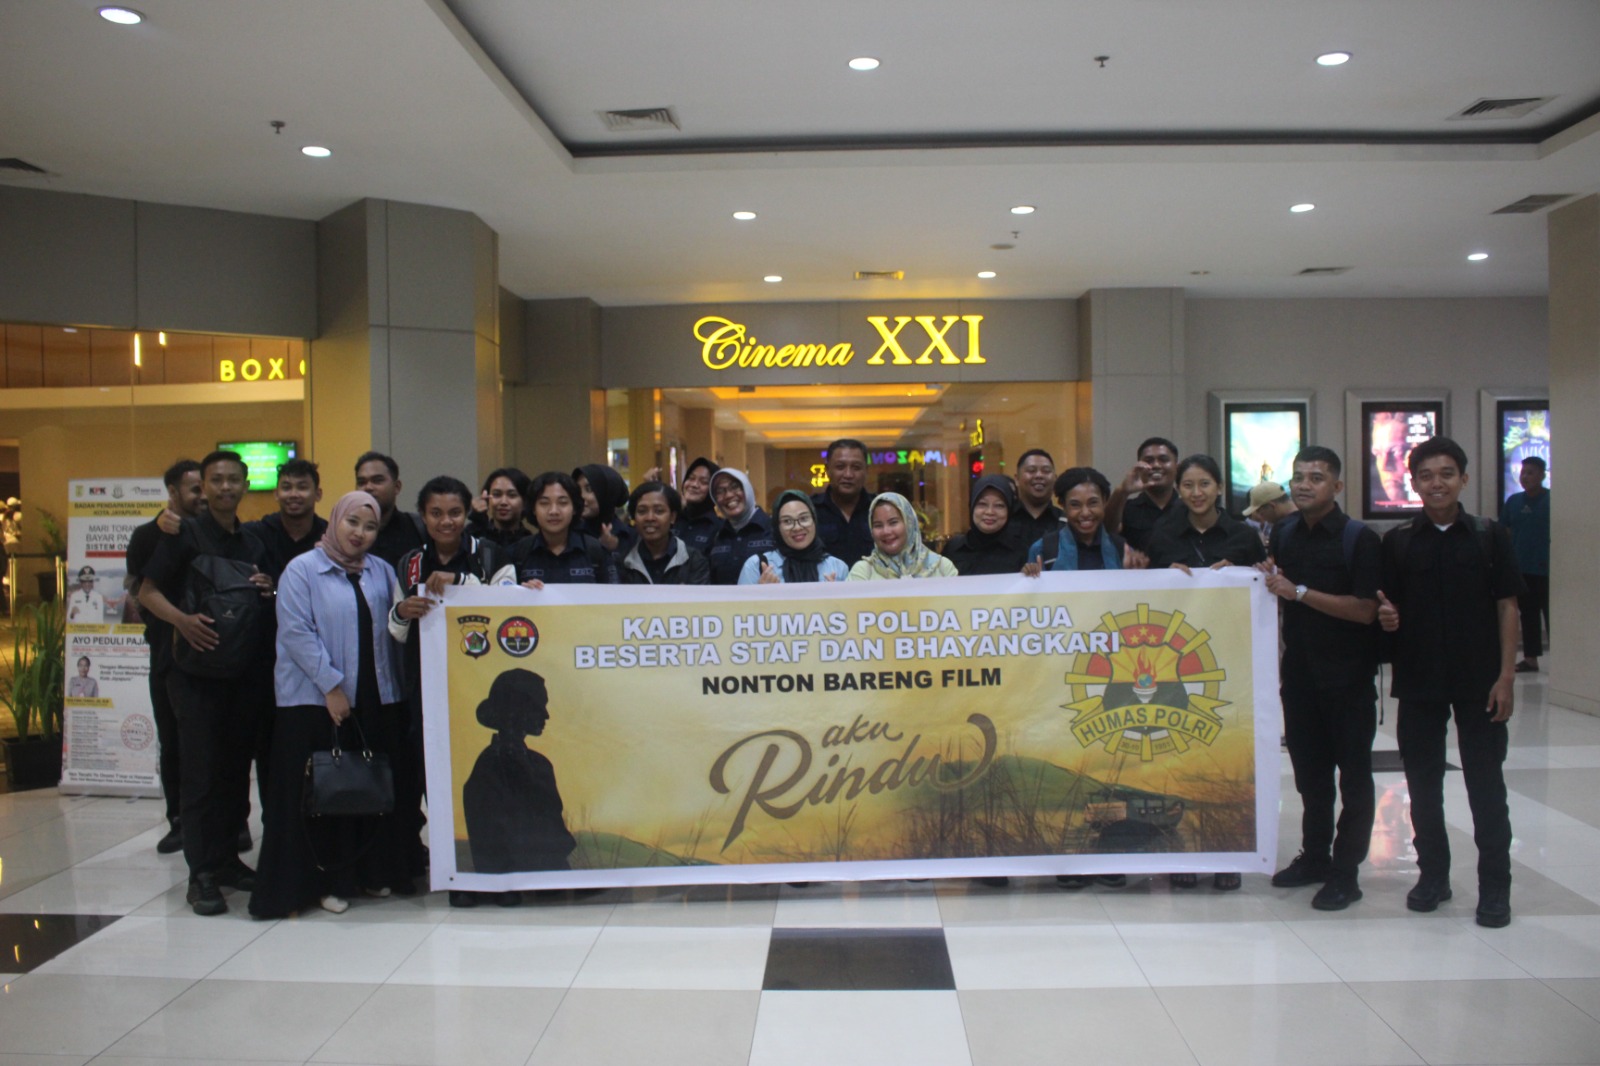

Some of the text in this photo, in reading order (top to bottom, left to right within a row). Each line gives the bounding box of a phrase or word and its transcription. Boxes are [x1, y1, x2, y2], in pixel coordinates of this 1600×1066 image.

[693, 315, 986, 370] Cinema XXI
[220, 358, 284, 381] BOX
[89, 486, 106, 495] KPK
[86, 533, 130, 542] BAYAR PA
[89, 524, 109, 532] MARI
[622, 606, 1073, 640] KABID HUMAS POLDA PAPUA
[72, 636, 149, 646] AYO PEDULI PAJA
[574, 631, 1120, 669] BESERTA STAF DAN BHAYANGKARI
[702, 668, 1001, 695] NONTON BARENG FILM
[821, 714, 904, 748] aku
[1079, 708, 1213, 742] HUMAS POLRI
[709, 712, 997, 855] Rindu
